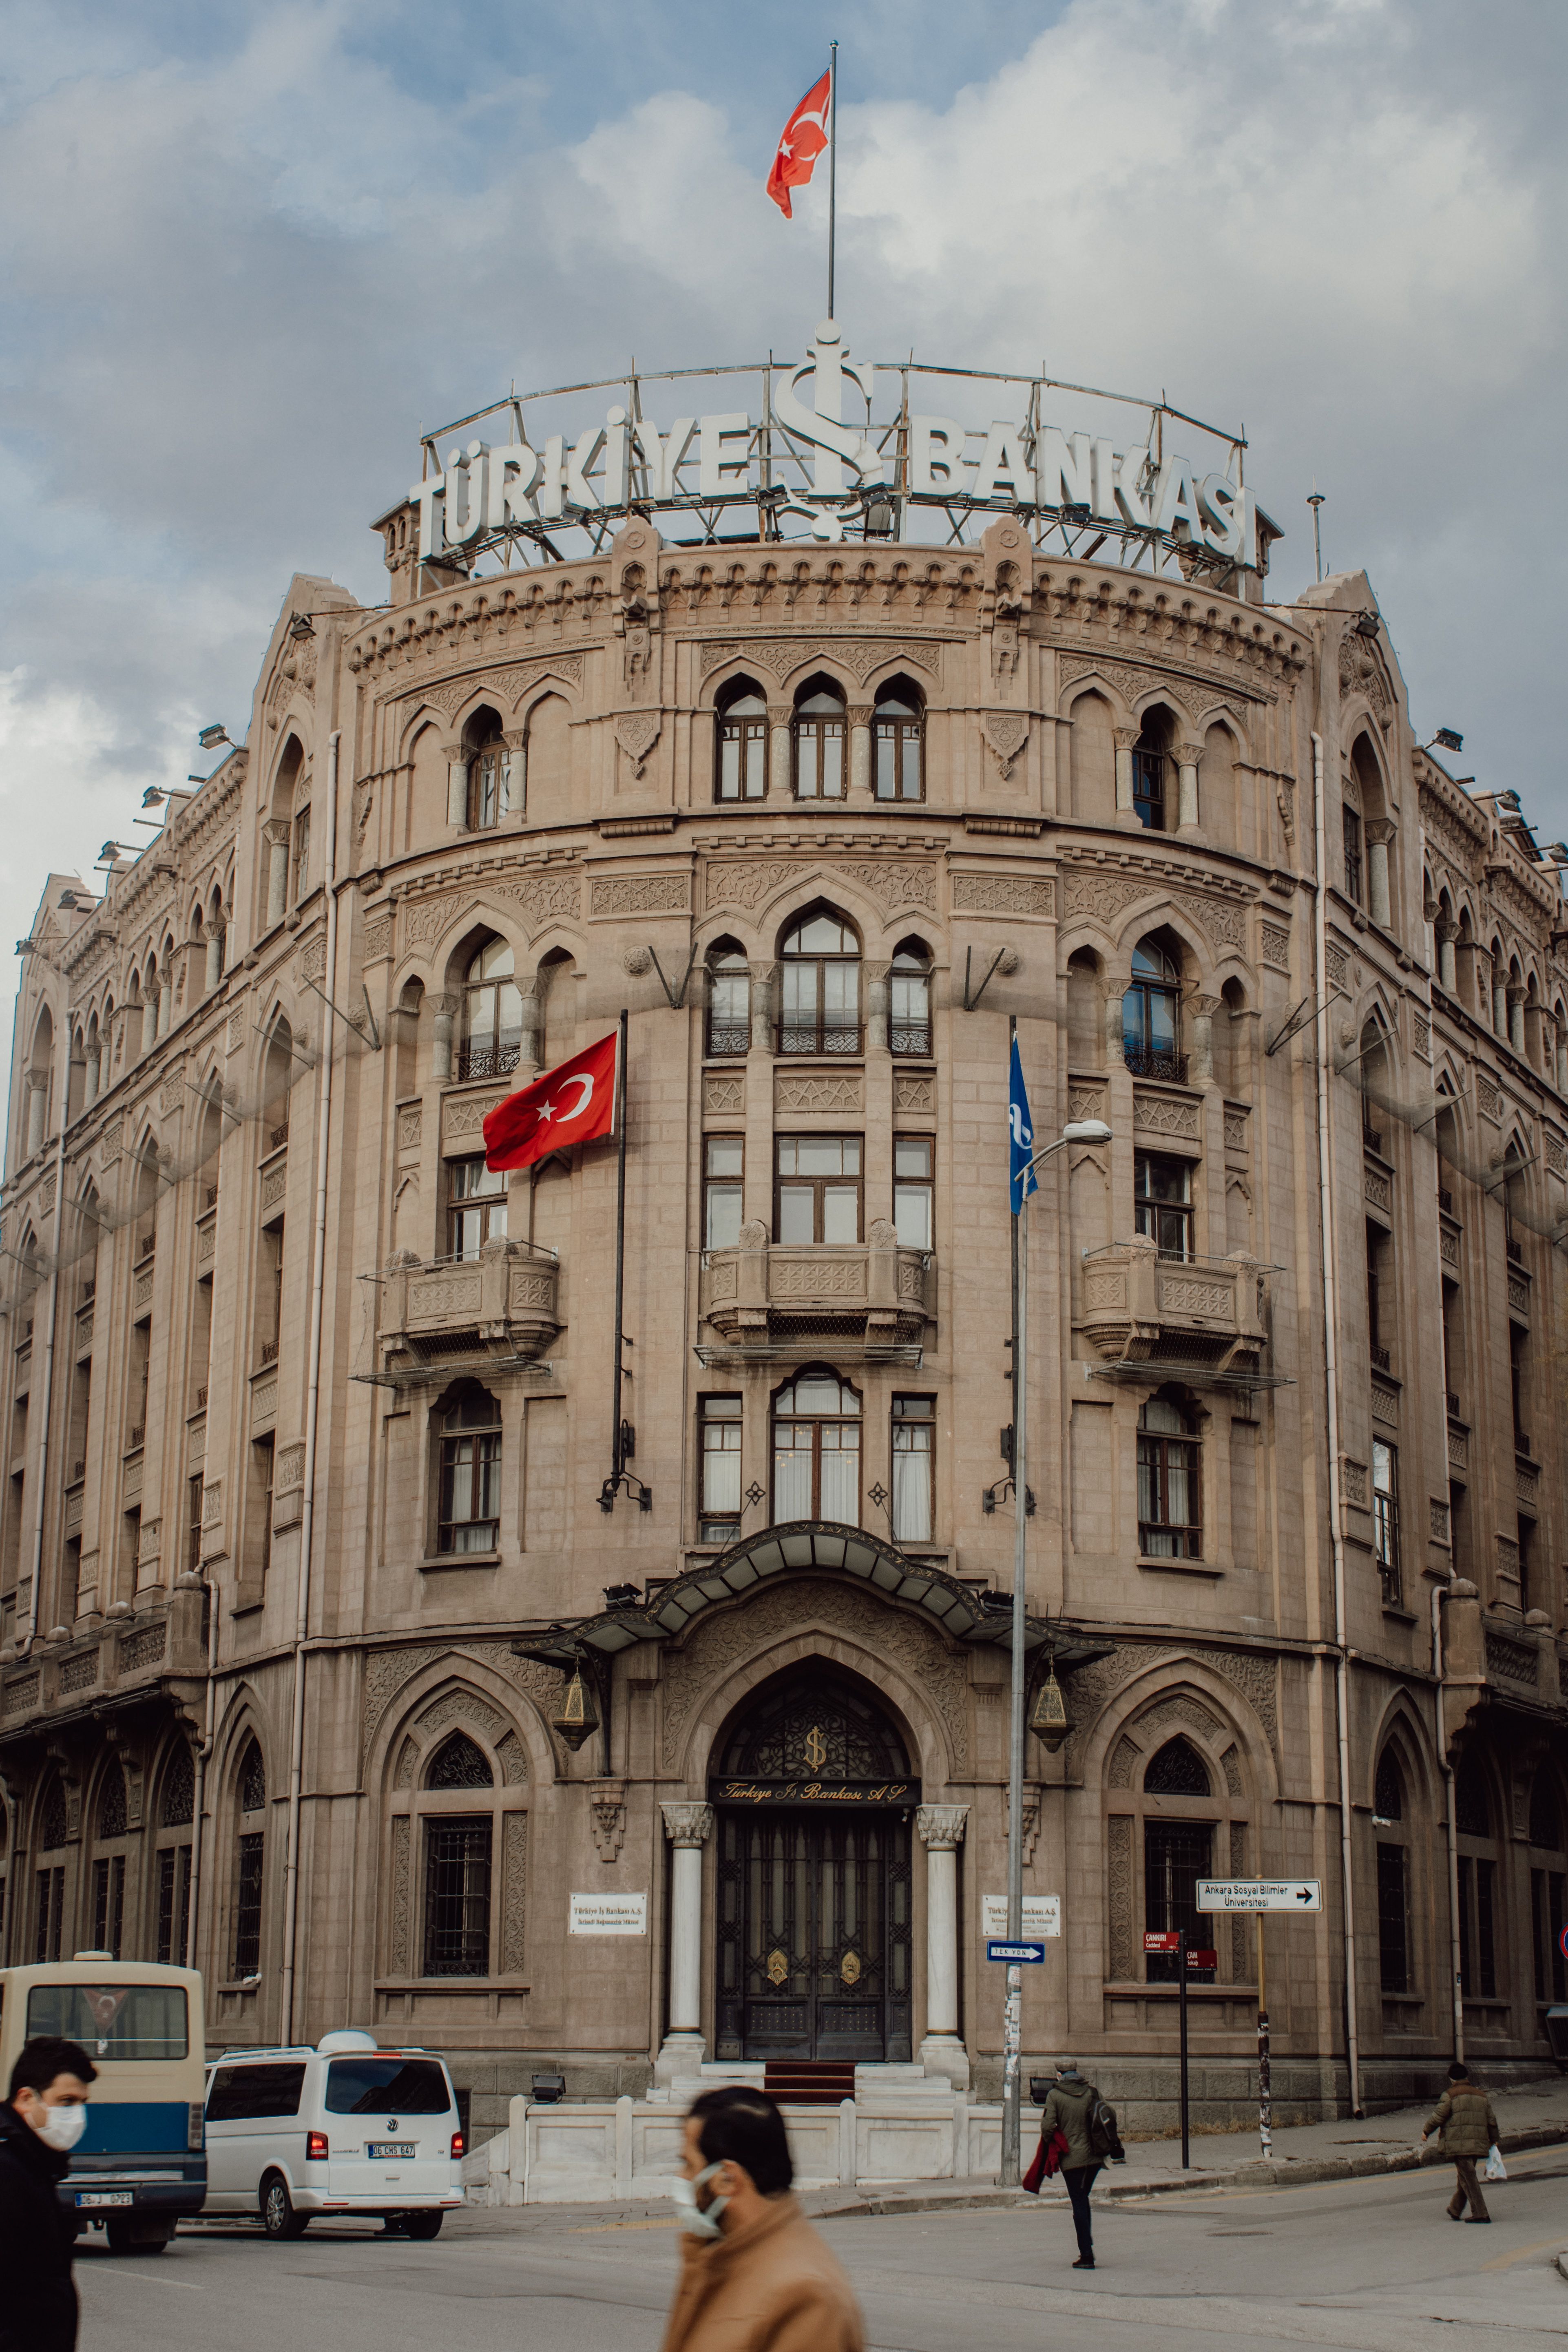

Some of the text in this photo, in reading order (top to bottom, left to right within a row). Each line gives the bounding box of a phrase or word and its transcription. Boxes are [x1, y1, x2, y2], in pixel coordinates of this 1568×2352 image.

[409, 406, 751, 564] TÜRKİYE
[910, 414, 1257, 569] BANKASI
[719, 1783, 772, 1802] Türkiye
[801, 1783, 863, 1800] Bankası
[1205, 1885, 1288, 1897] Ankara Sosyal Bilimler
[1225, 1895, 1269, 1907] Üniversitesi
[574, 1907, 597, 1916] Türkiye
[988, 1906, 1008, 1916] Türkiy
[1187, 1952, 1198, 1960] ÇAM
[374, 2146, 413, 2154] 06 CHS 647
